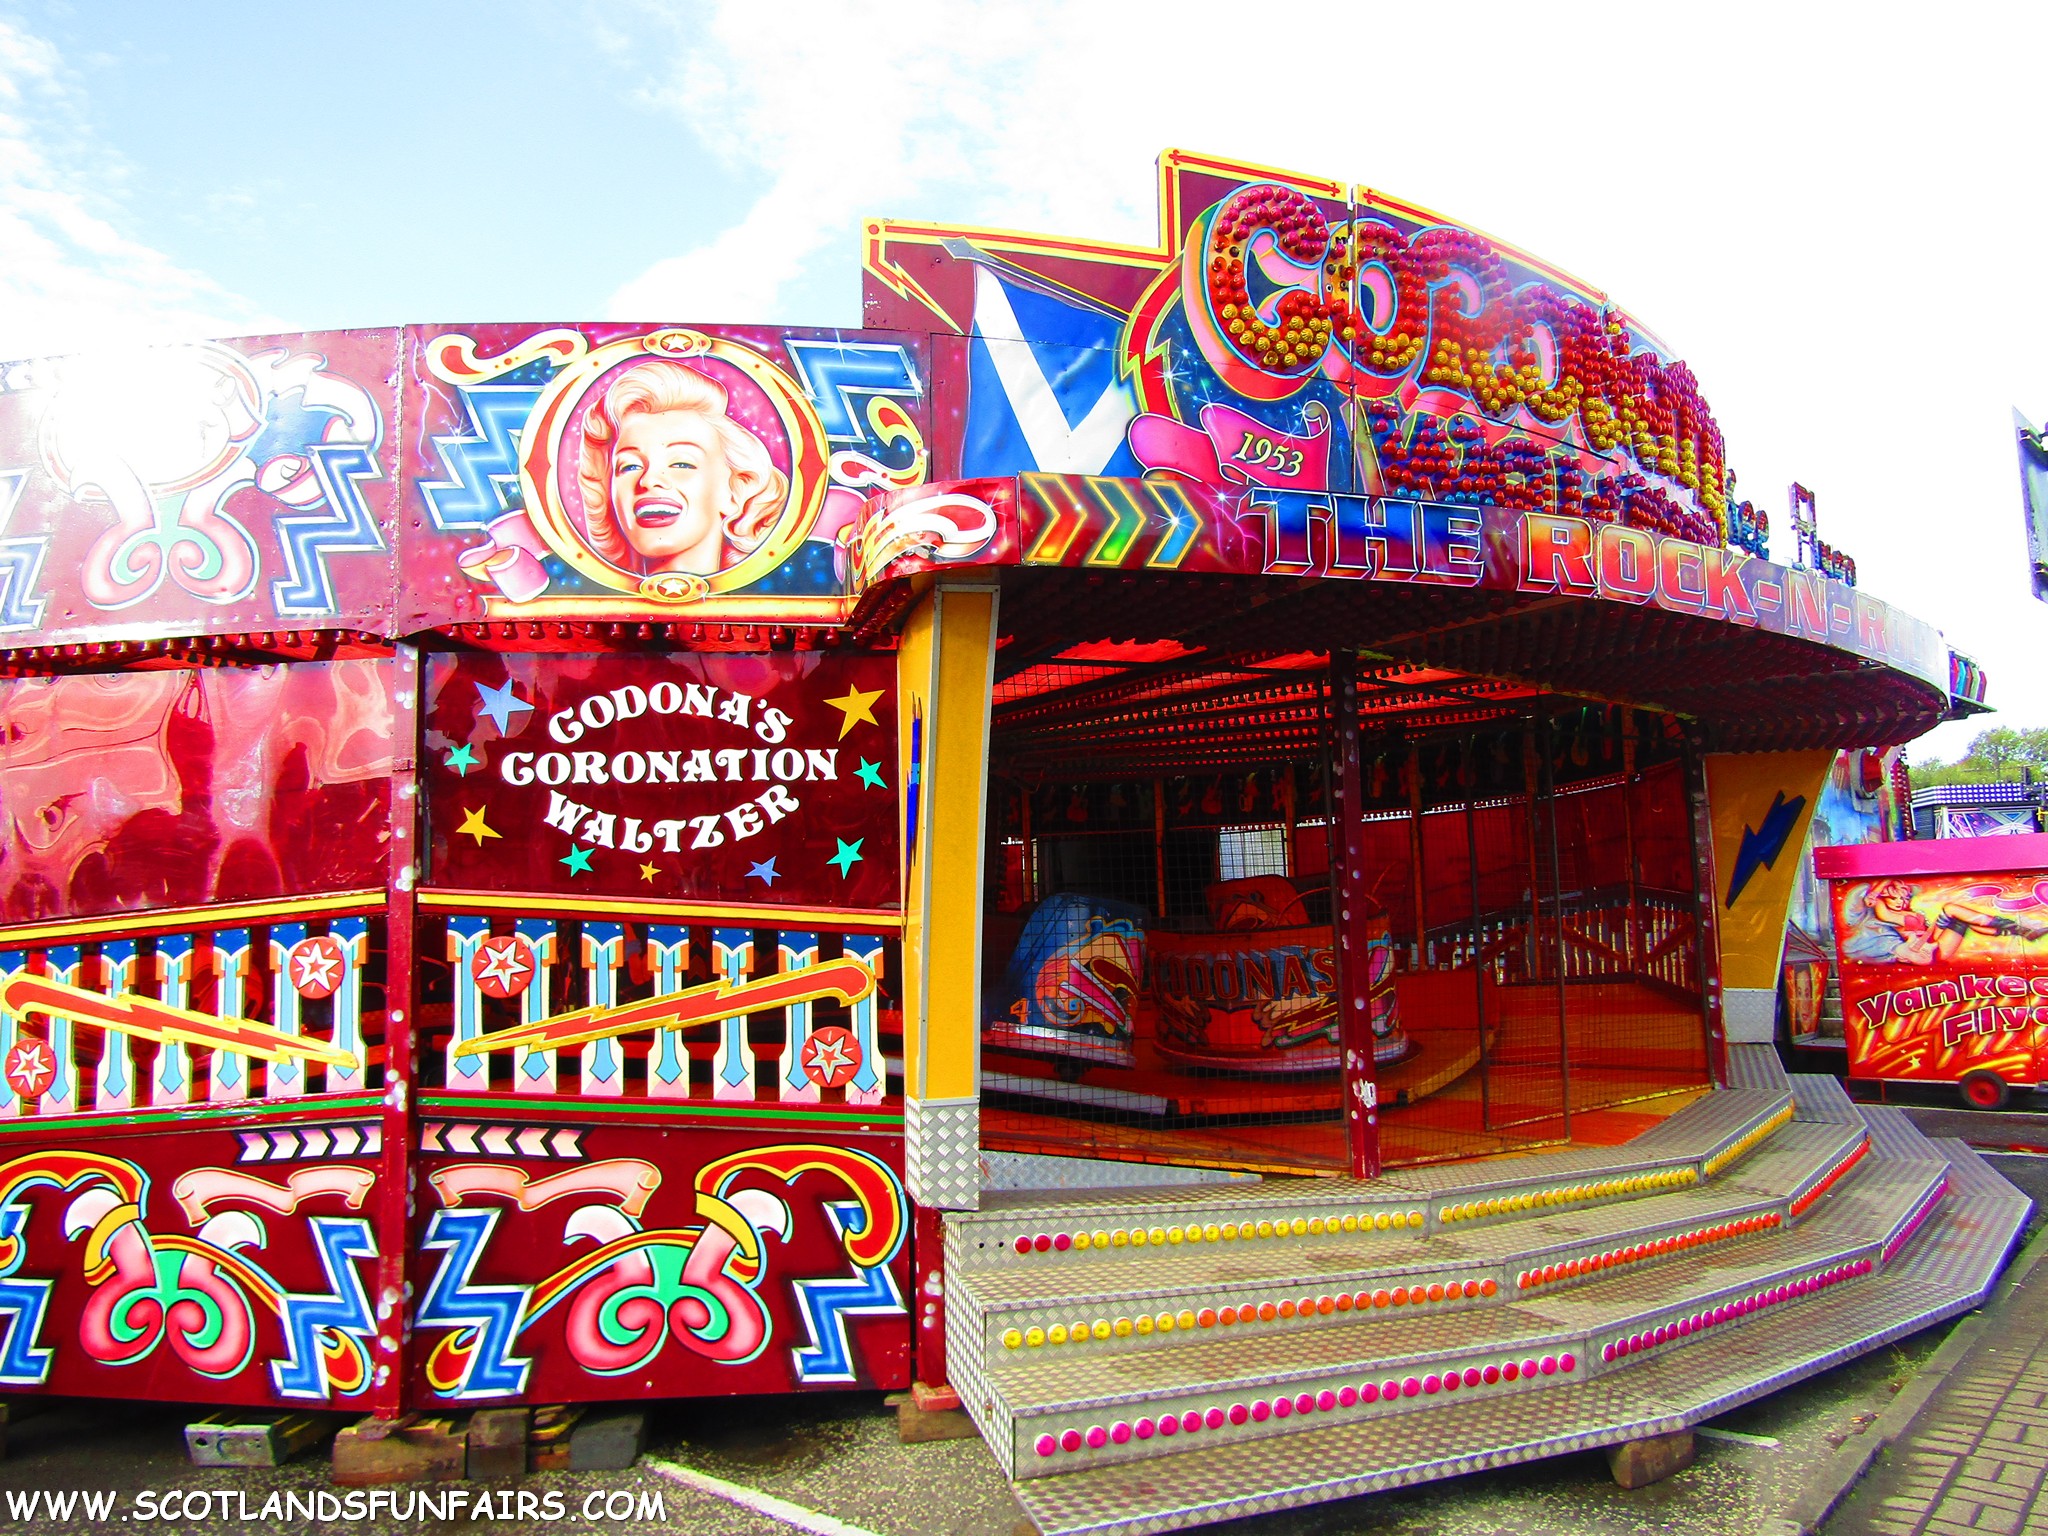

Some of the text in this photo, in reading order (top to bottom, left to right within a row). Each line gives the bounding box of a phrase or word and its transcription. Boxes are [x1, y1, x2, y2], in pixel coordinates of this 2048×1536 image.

[1234, 431, 1304, 478] 1953
[1236, 486, 1485, 588] THE
[1516, 511, 1940, 680] ROCK-N-ROL
[547, 681, 795, 744] CODONA'S
[500, 747, 840, 787] CORONATION
[543, 784, 801, 854] WALTZER
[1009, 997, 1028, 1025] 4
